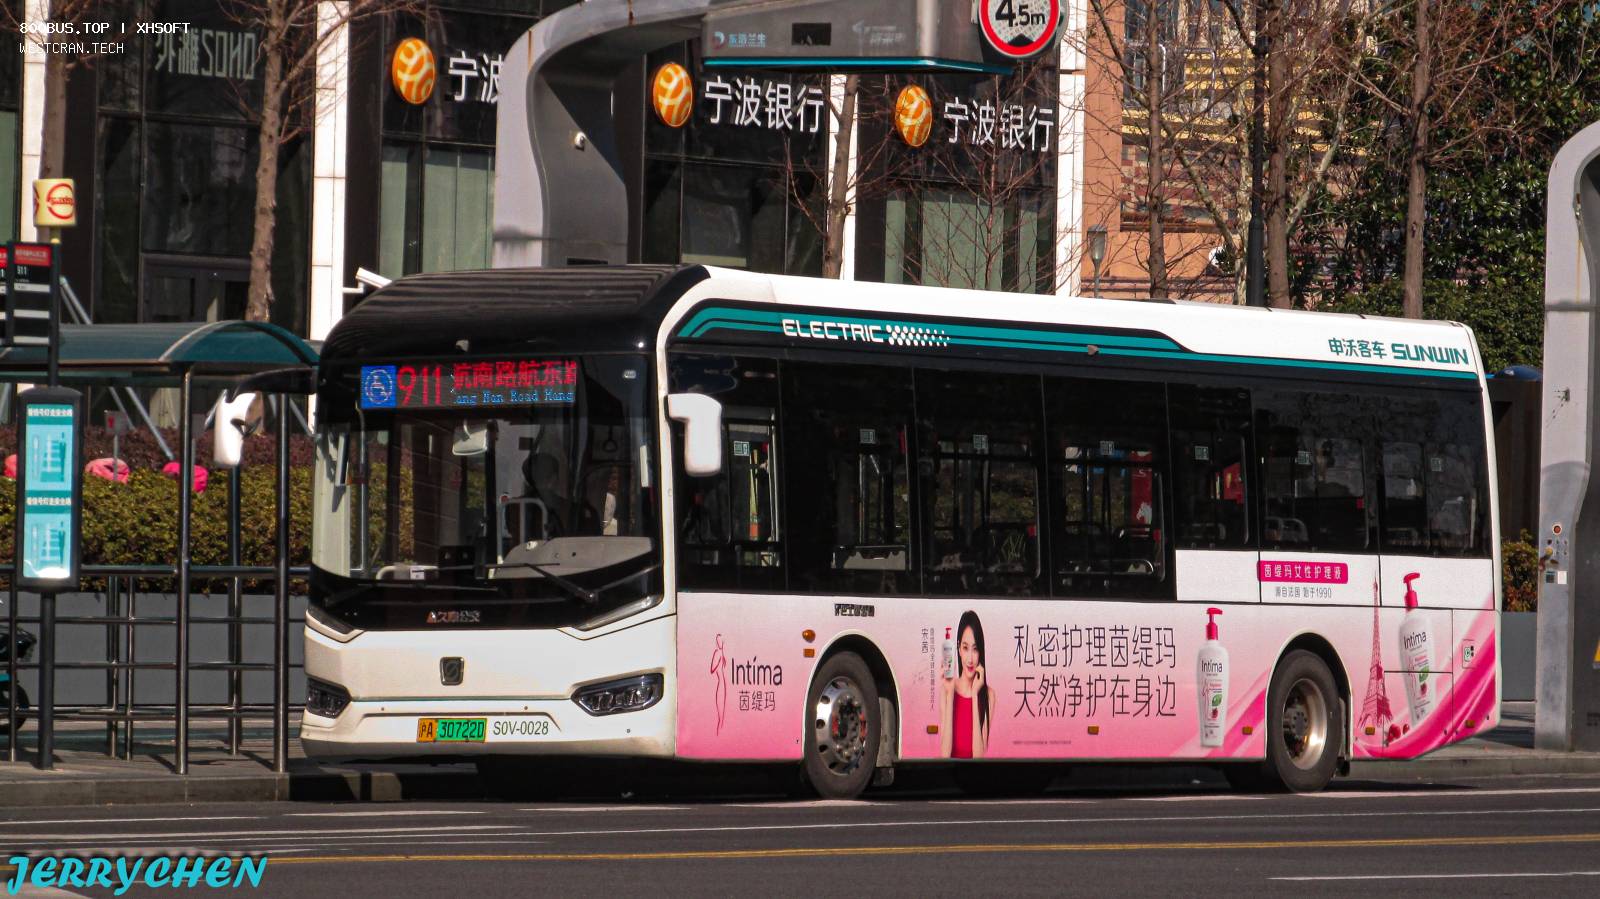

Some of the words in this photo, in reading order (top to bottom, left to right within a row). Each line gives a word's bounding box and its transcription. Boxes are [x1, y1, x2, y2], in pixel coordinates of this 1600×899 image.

[704, 76, 824, 133] 宁波银行
[943, 97, 1053, 152] 宁波银行
[782, 319, 884, 343] ELECTRIC
[1328, 338, 1387, 359] 申沃客车
[1391, 343, 1469, 365] SUNWIN
[397, 367, 442, 406] 911
[1014, 624, 1176, 668] 私密护理茵缇玛
[738, 690, 776, 711] 茵缇玛
[1013, 674, 1177, 719] 天然净护在身边
